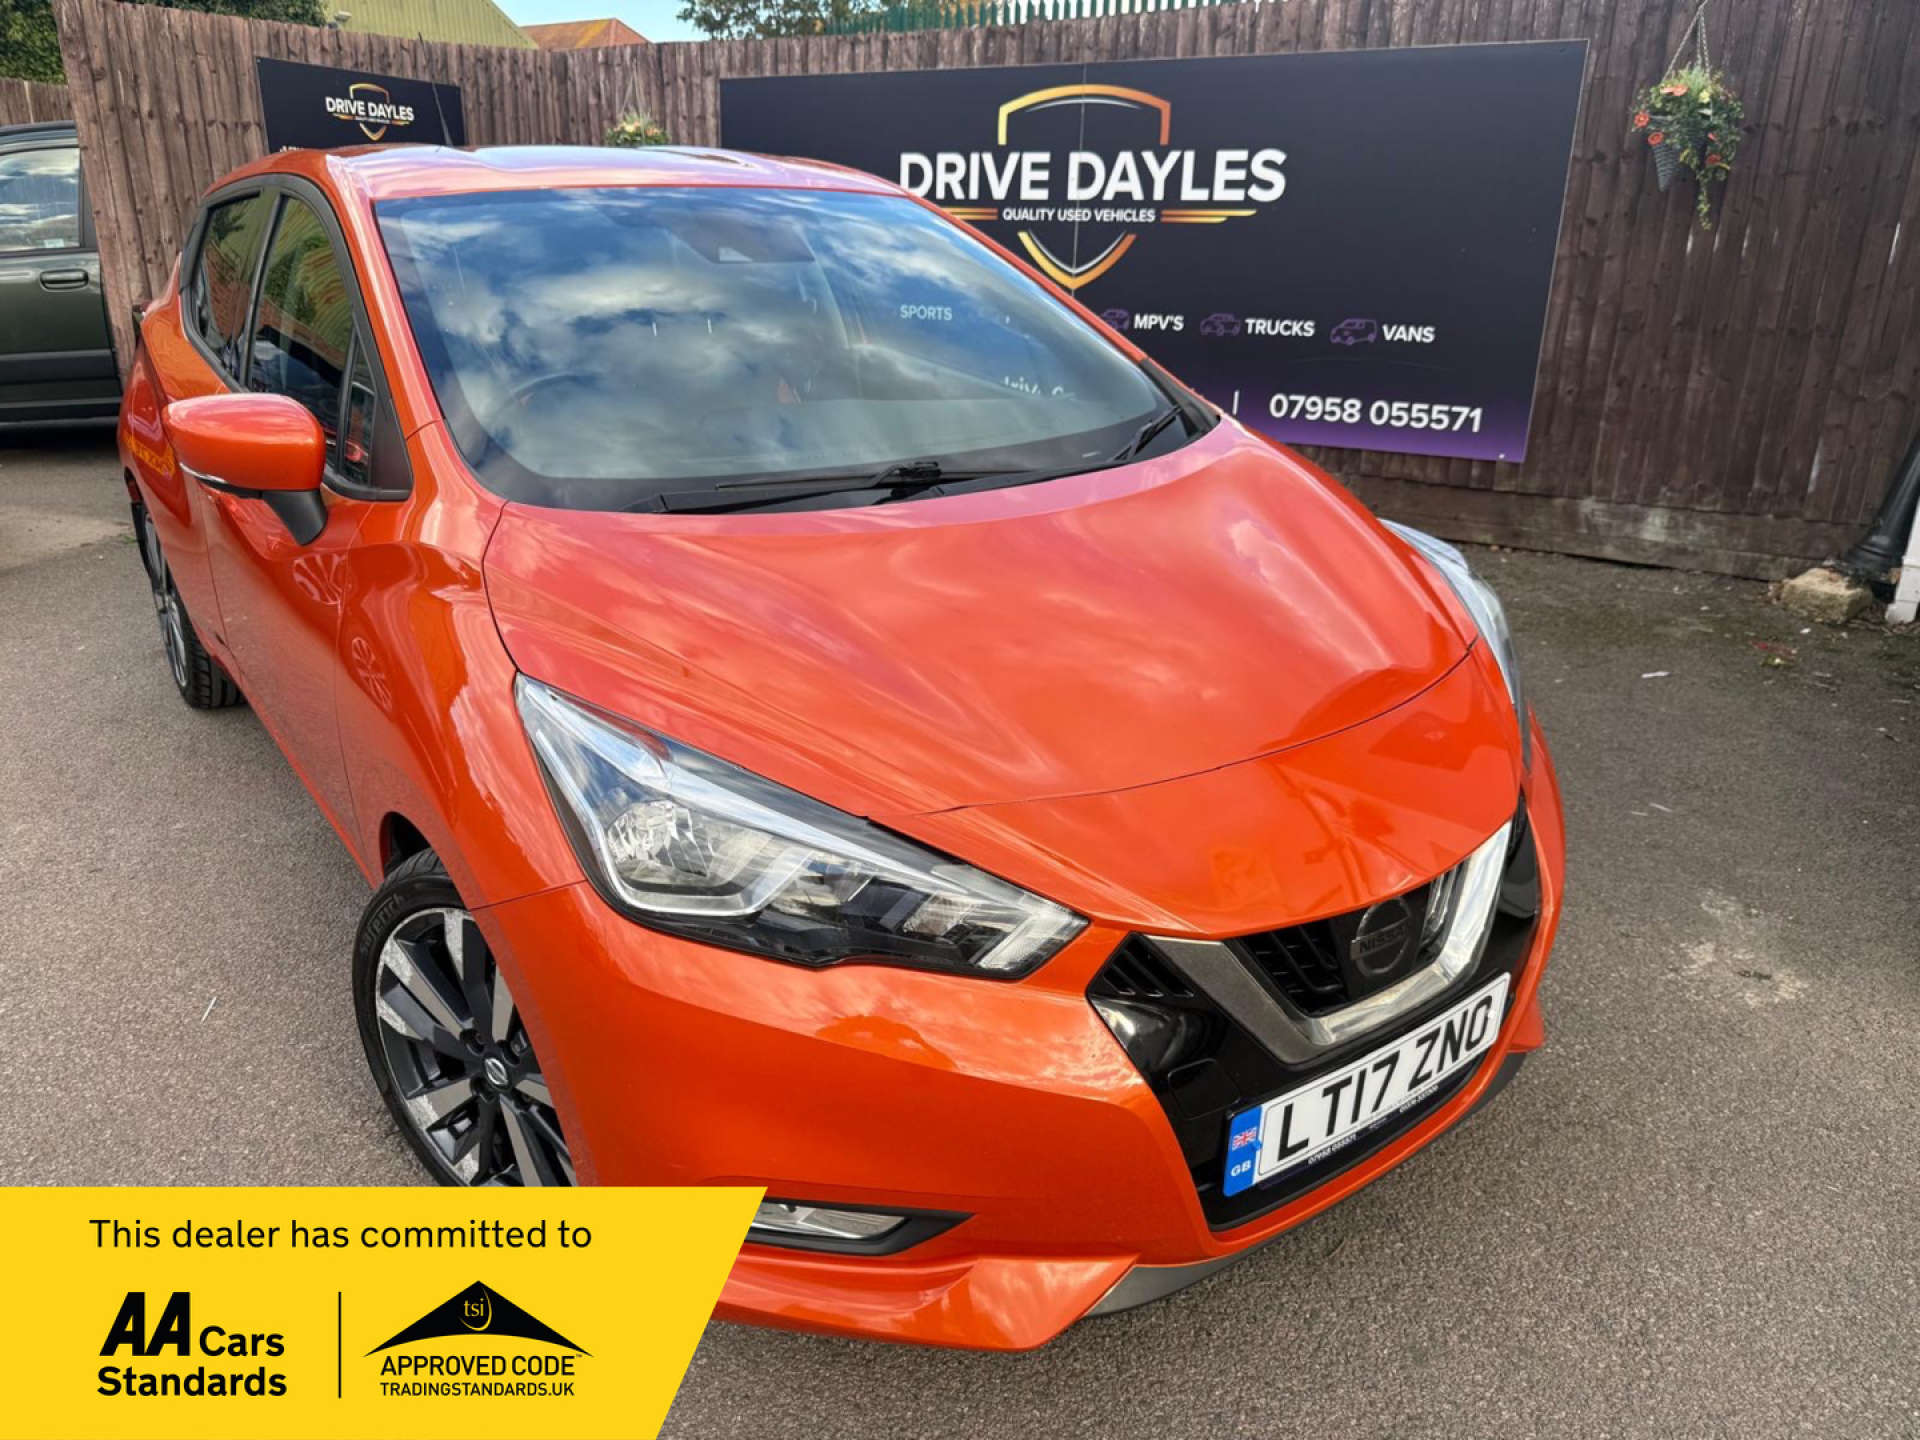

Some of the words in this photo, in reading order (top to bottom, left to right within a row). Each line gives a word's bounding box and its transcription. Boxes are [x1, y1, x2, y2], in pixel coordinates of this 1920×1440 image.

[325, 96, 366, 116] DRIVE
[367, 102, 415, 121] DAYLES
[899, 151, 1051, 200] DRIVE
[1066, 149, 1288, 203] DAYLES
[1002, 207, 1056, 222] QUALITY
[1056, 208, 1093, 222] USED
[1094, 208, 1157, 223] VEHICLES
[900, 304, 953, 321] SPORTS
[1133, 313, 1185, 331] MPV'S
[1245, 318, 1316, 338] TRUCKS
[1382, 324, 1436, 344] VANS
[1269, 393, 1361, 423] 07958
[1369, 400, 1483, 433] 055571
[1407, 995, 1493, 1091] ZNO
[1230, 1159, 1252, 1177] GB
